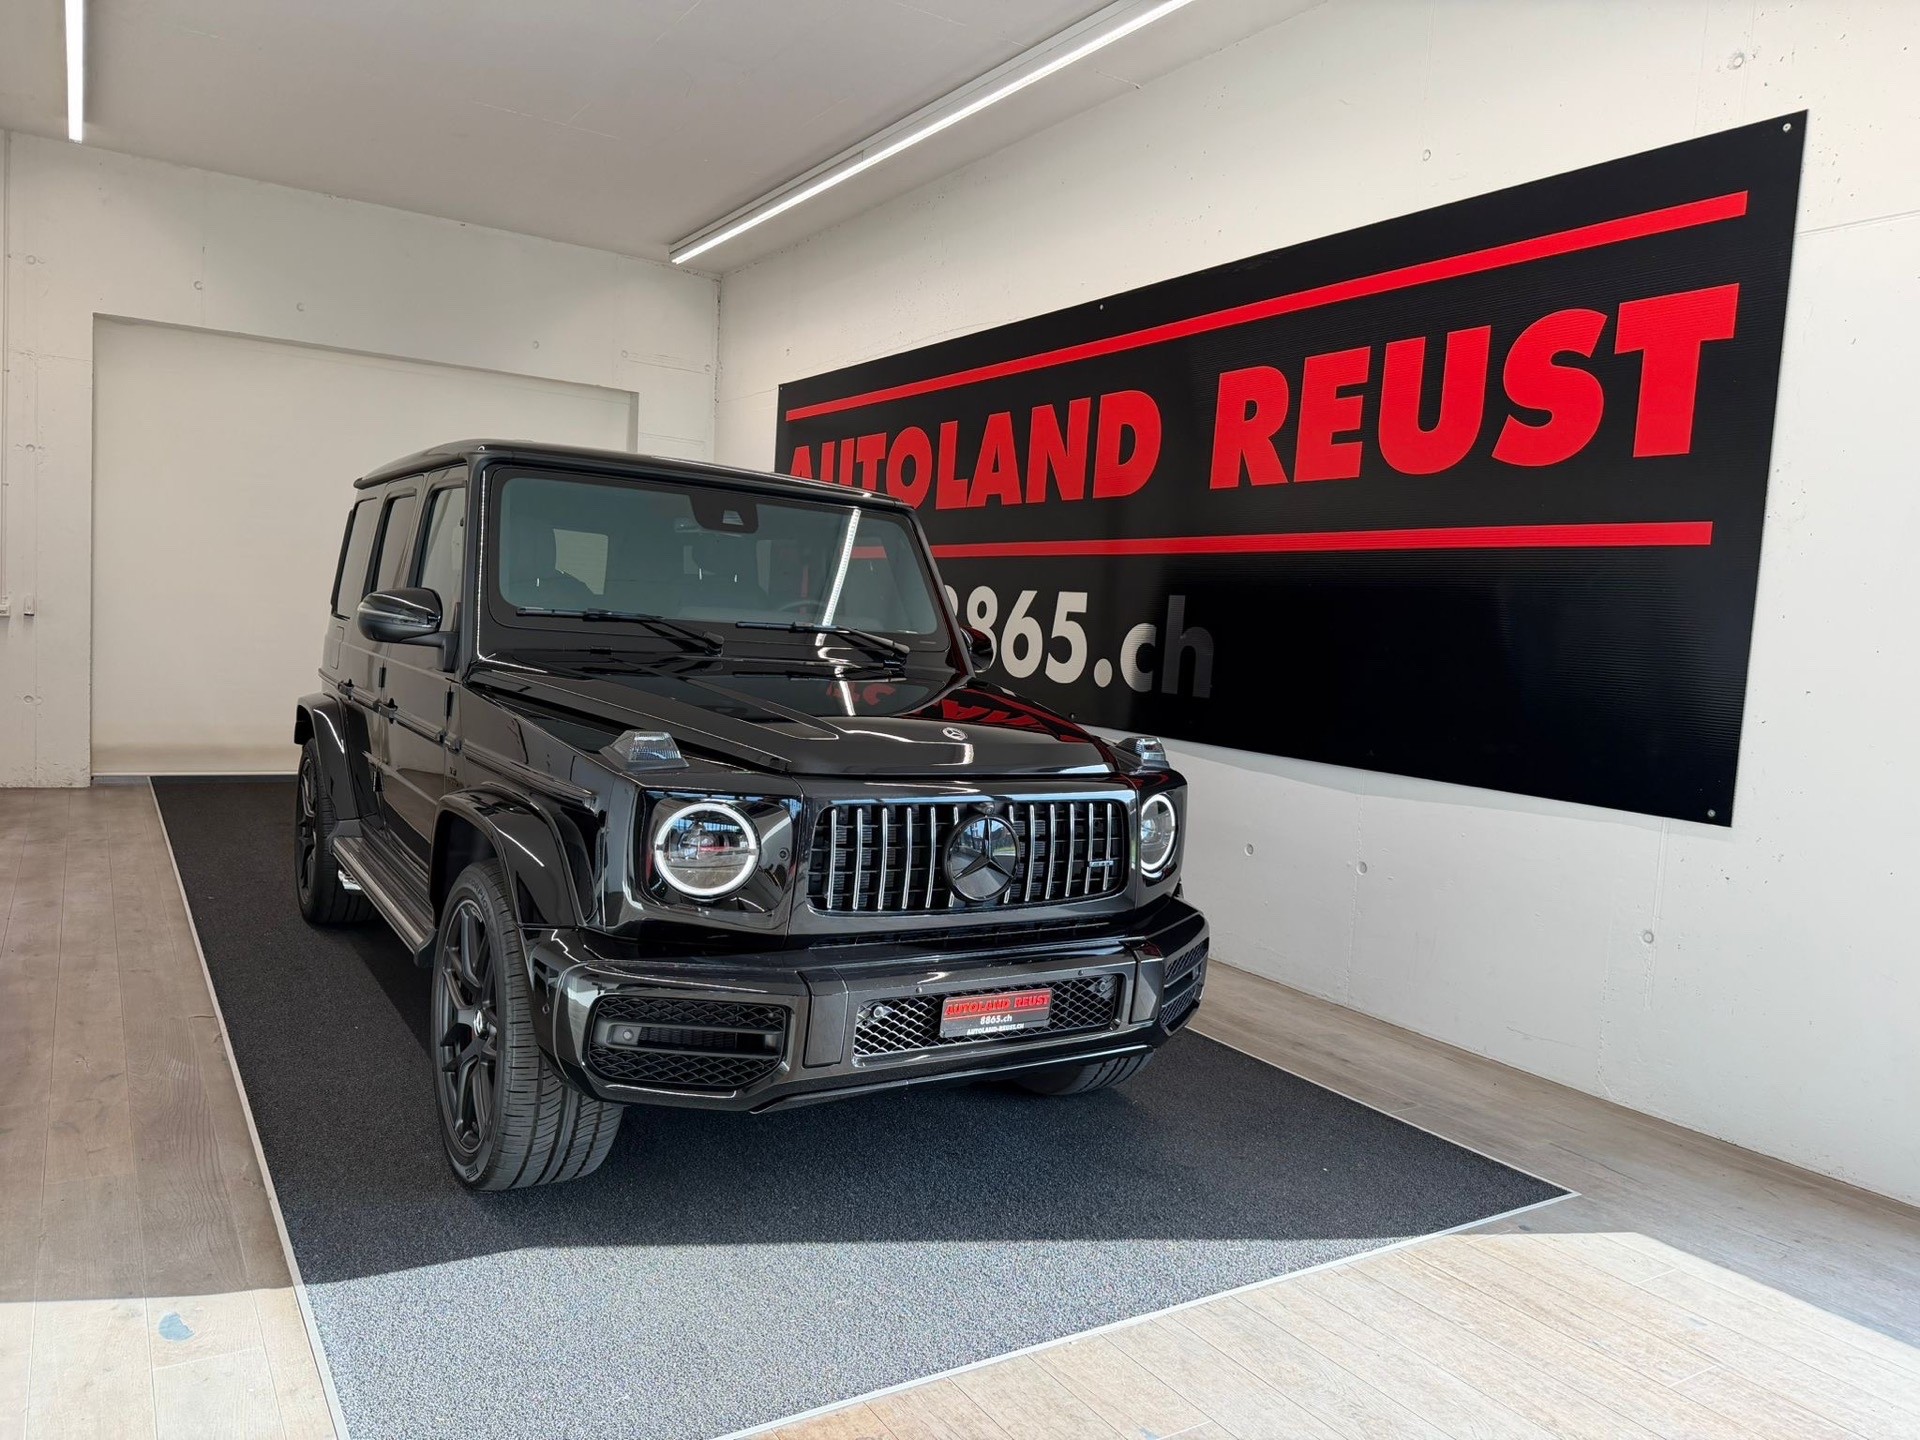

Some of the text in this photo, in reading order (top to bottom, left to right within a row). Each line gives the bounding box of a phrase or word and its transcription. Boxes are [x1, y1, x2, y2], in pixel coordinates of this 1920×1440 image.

[789, 283, 1739, 510] AUTOLAND REUST
[946, 995, 1049, 1015] AUTOLAND REUST
[980, 1014, 1013, 1025] 8865.ch
